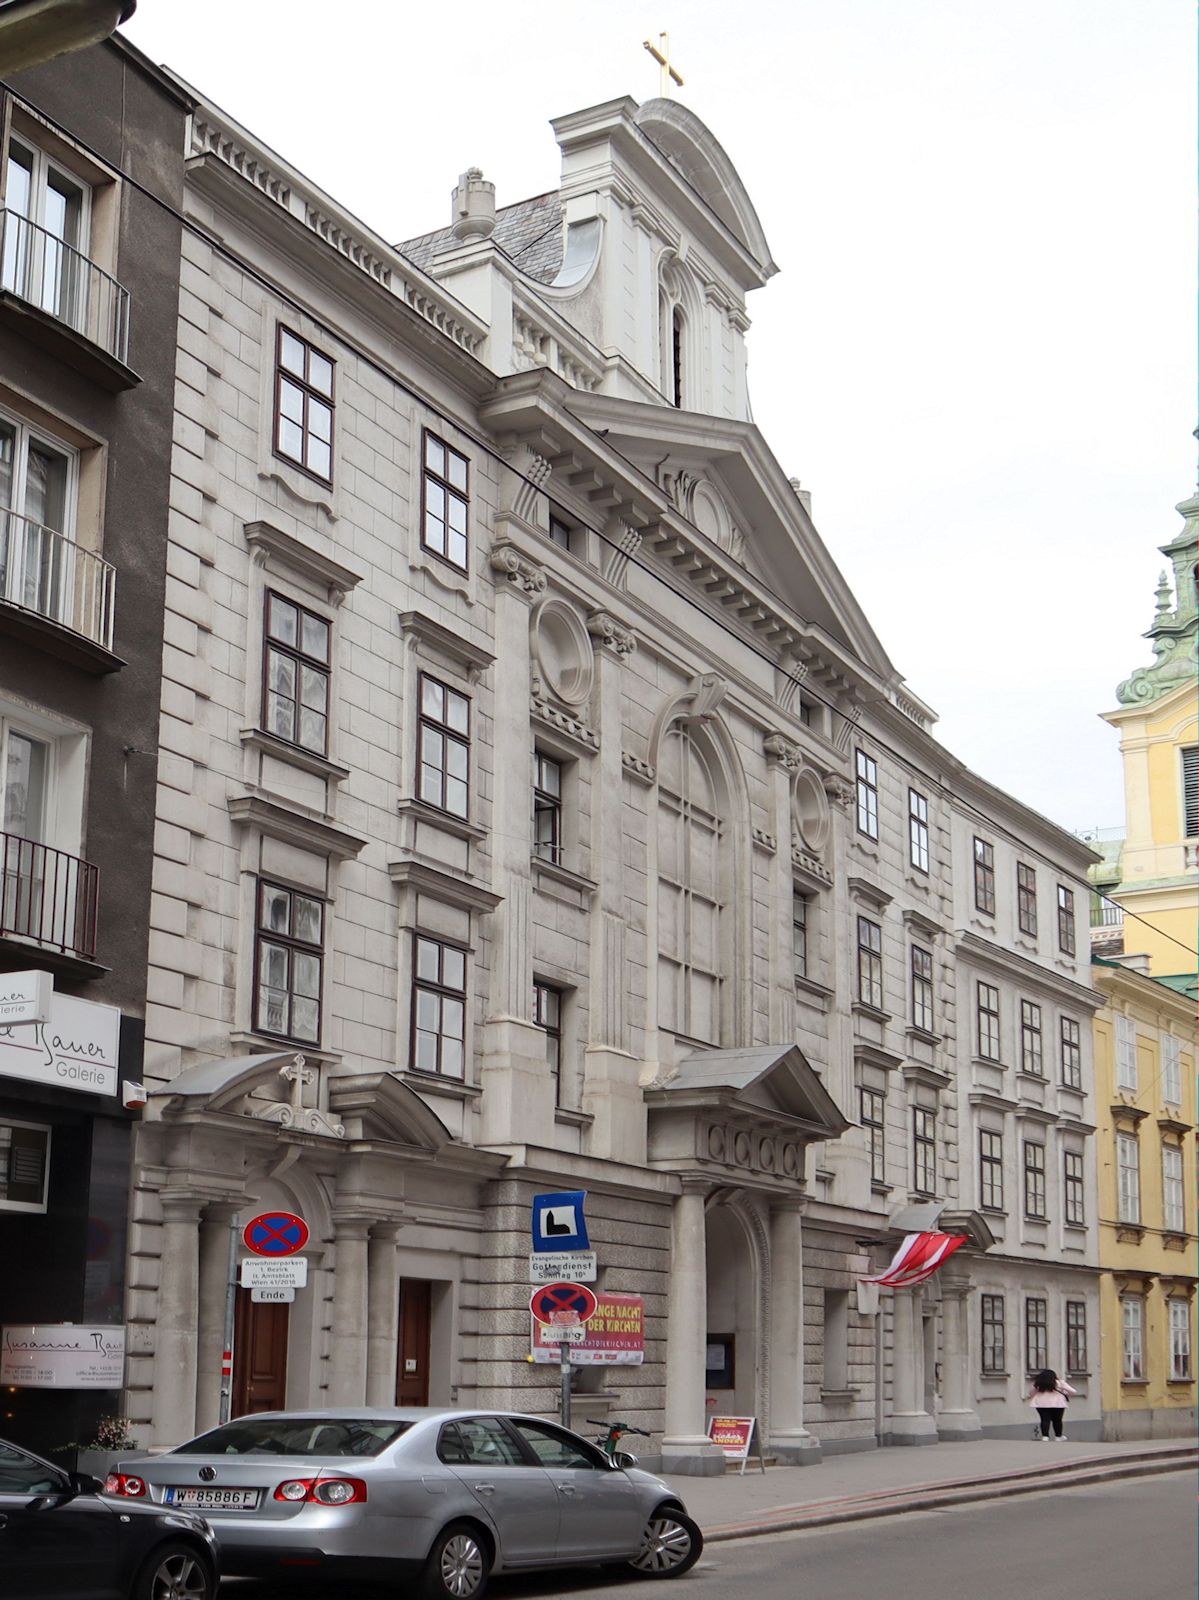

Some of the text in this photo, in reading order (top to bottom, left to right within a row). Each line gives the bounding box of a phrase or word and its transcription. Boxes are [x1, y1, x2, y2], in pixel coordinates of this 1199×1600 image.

[56, 1061, 105, 1085] Galerie
[538, 1272, 571, 1280] Sonntag
[260, 1291, 286, 1300] Ende
[594, 1304, 642, 1320] ANGE NACHT
[588, 1319, 641, 1333] DER KIRCHEN
[6, 1331, 82, 1355] Susanne
[177, 1490, 252, 1503] W 85886 F
